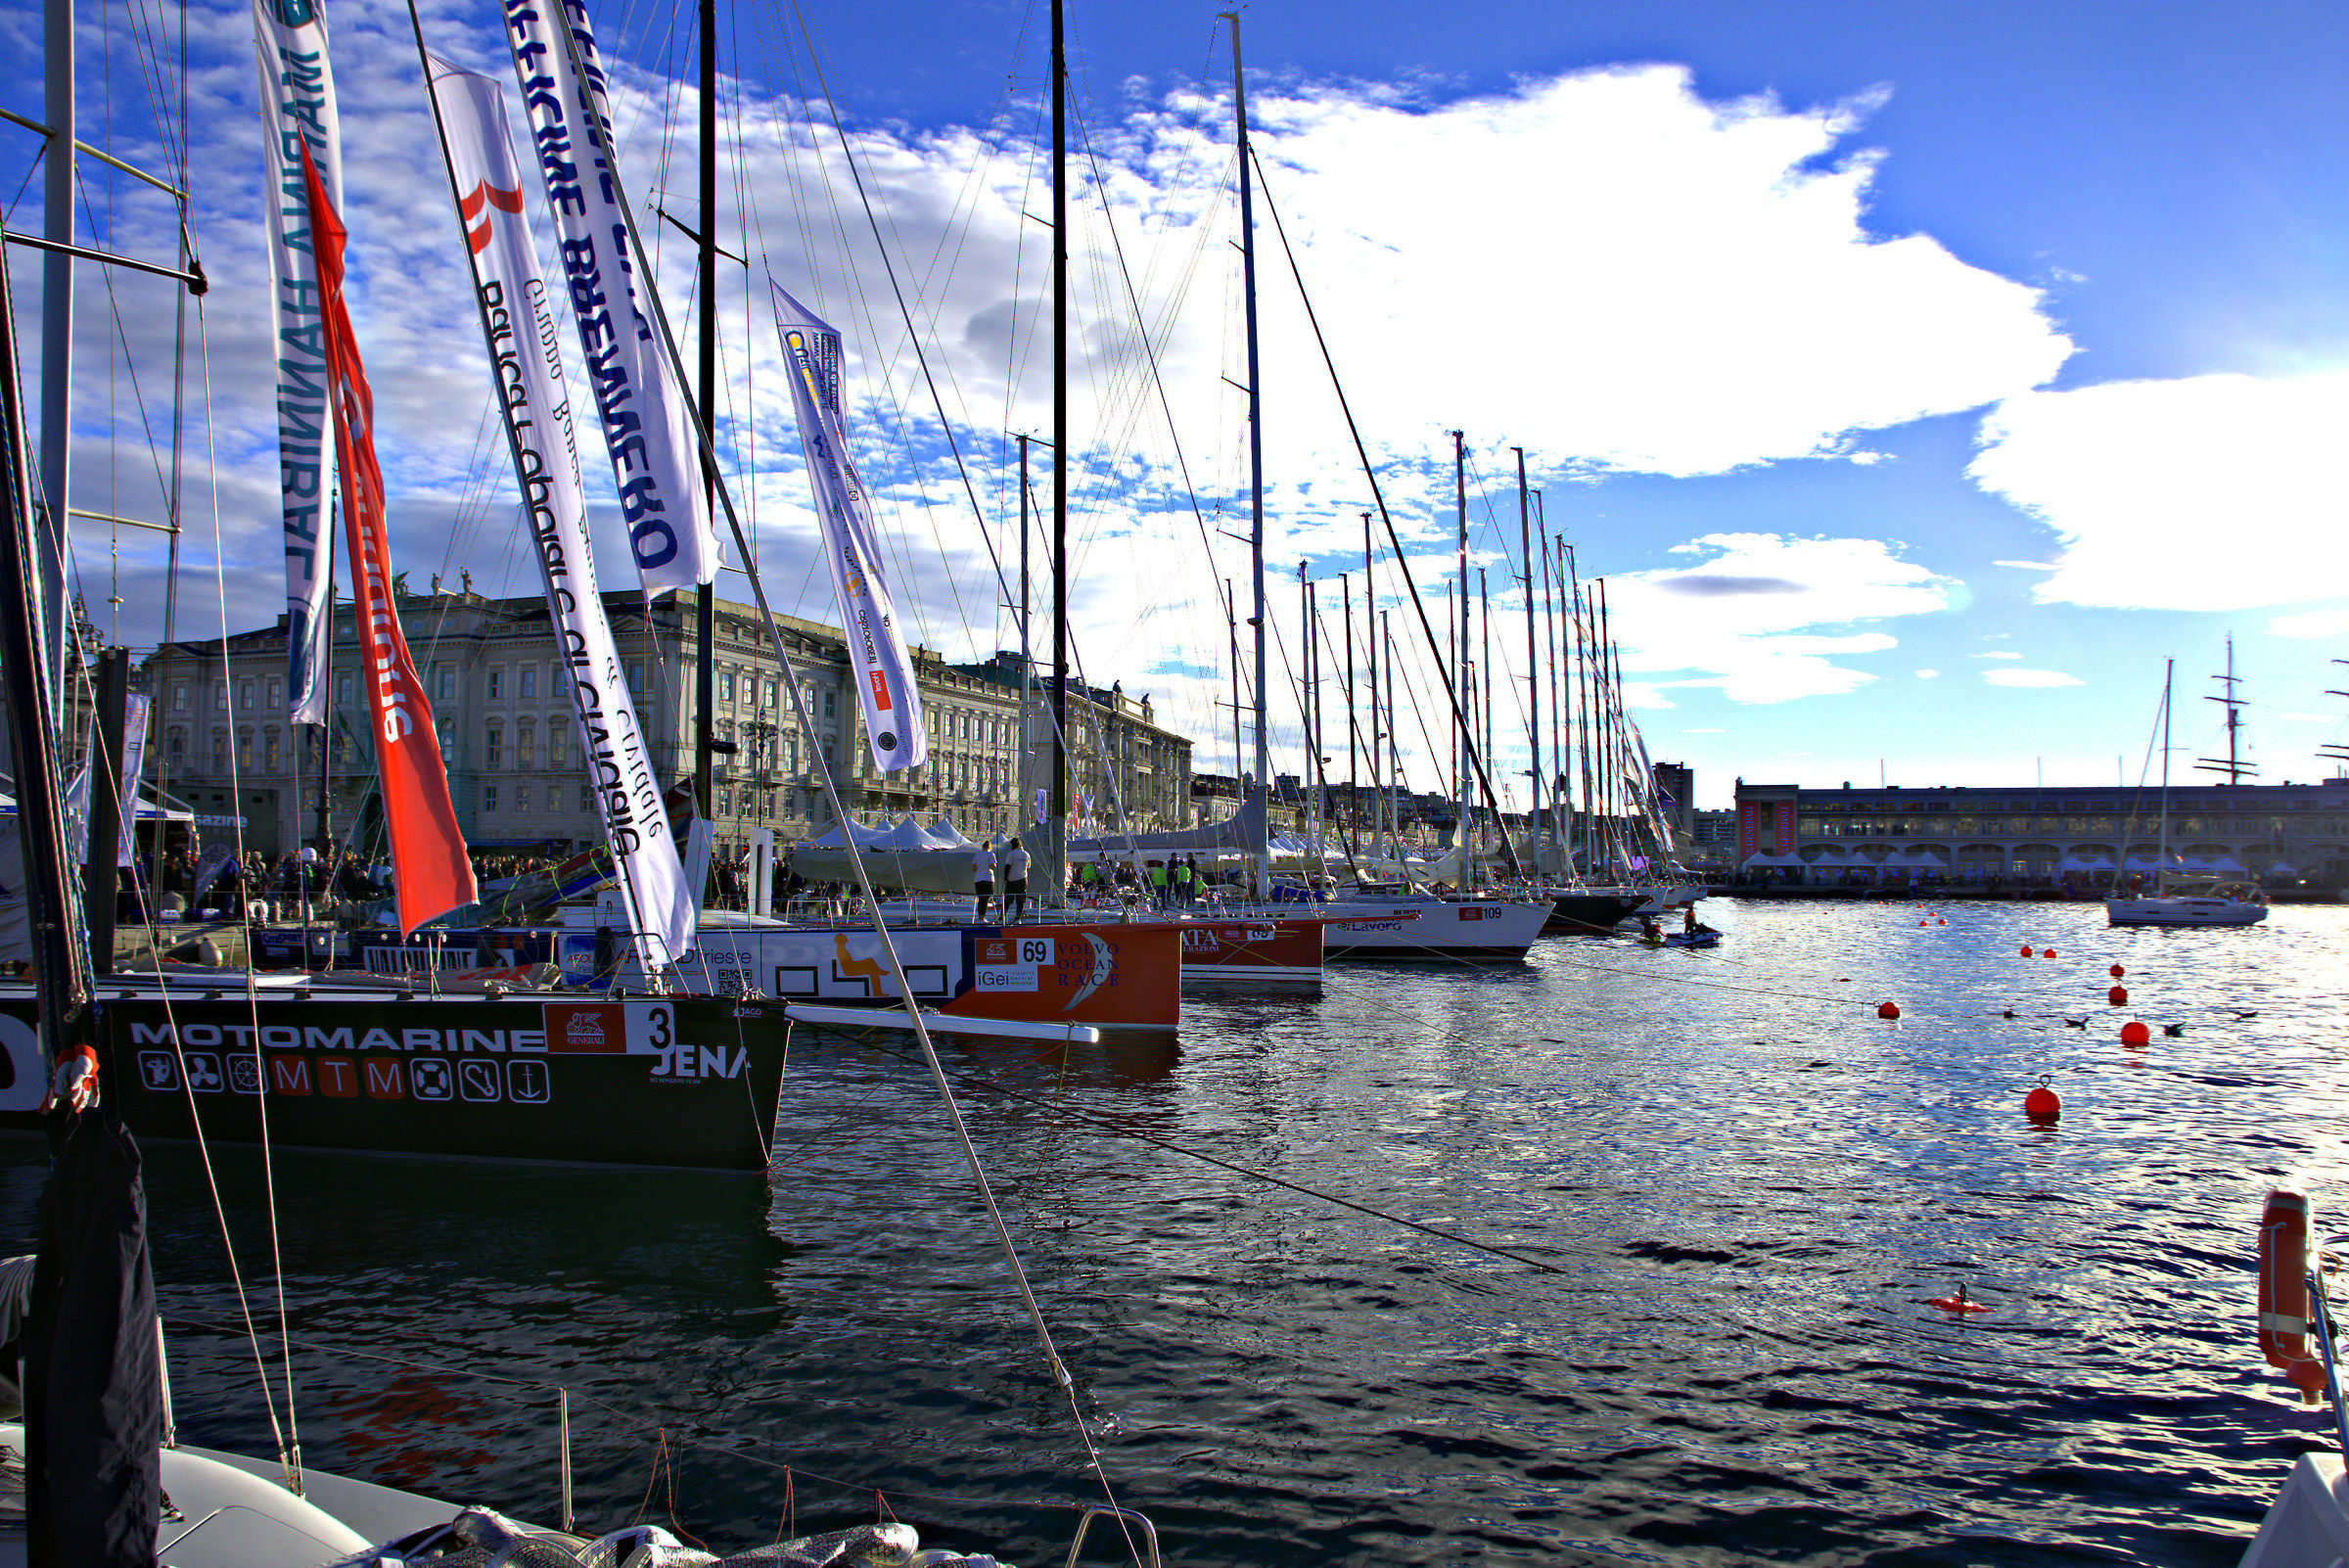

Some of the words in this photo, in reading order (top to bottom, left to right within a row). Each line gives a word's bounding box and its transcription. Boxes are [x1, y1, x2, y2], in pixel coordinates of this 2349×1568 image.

[1483, 907, 1502, 919] 109
[1023, 941, 1046, 962] 69
[1057, 944, 1119, 955] VOLVO
[1057, 958, 1119, 970] OCEAN
[979, 971, 1009, 986] iGei
[1057, 974, 1120, 987] RACE
[648, 1007, 671, 1049] 3
[129, 1022, 547, 1054] MOTOMARINE
[567, 1037, 605, 1045] GENERALI
